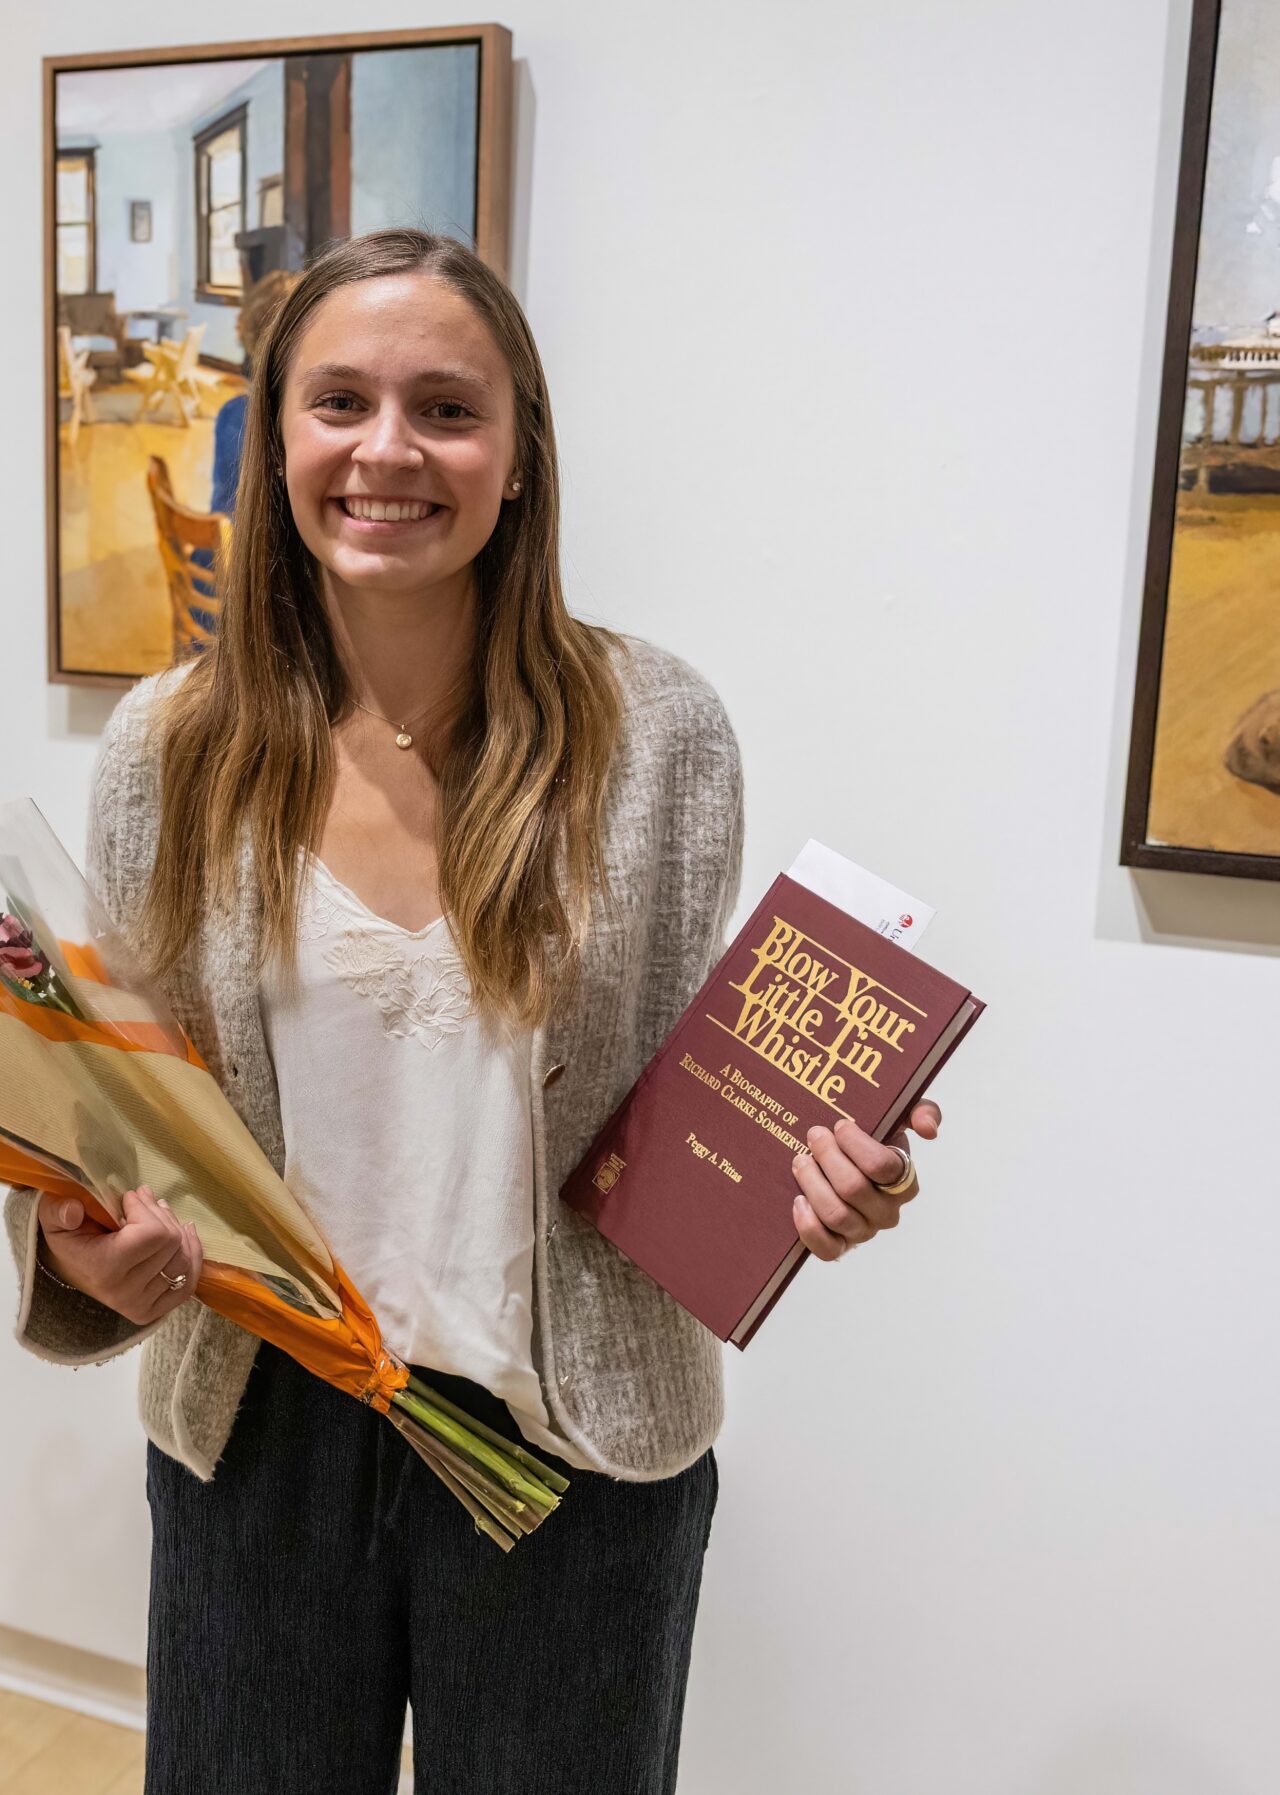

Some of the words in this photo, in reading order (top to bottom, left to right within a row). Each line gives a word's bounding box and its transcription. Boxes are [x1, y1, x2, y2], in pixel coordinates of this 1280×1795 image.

[736, 954, 823, 1037] Little
[825, 1011, 883, 1086] Tin
[754, 916, 839, 992] Blow
[835, 968, 916, 1051] Your
[720, 1063, 732, 1077] A
[729, 1068, 784, 1116] BIOGRAPHY
[782, 1111, 799, 1127] OF
[734, 994, 846, 1103] Whistle
[679, 1052, 721, 1091] RICHARD
[720, 1084, 757, 1118] CLARKE
[755, 1110, 812, 1155] SOMMERVIL
[685, 1132, 711, 1159] Peggy
[707, 1152, 718, 1165] A.
[718, 1158, 743, 1183] Pittas
